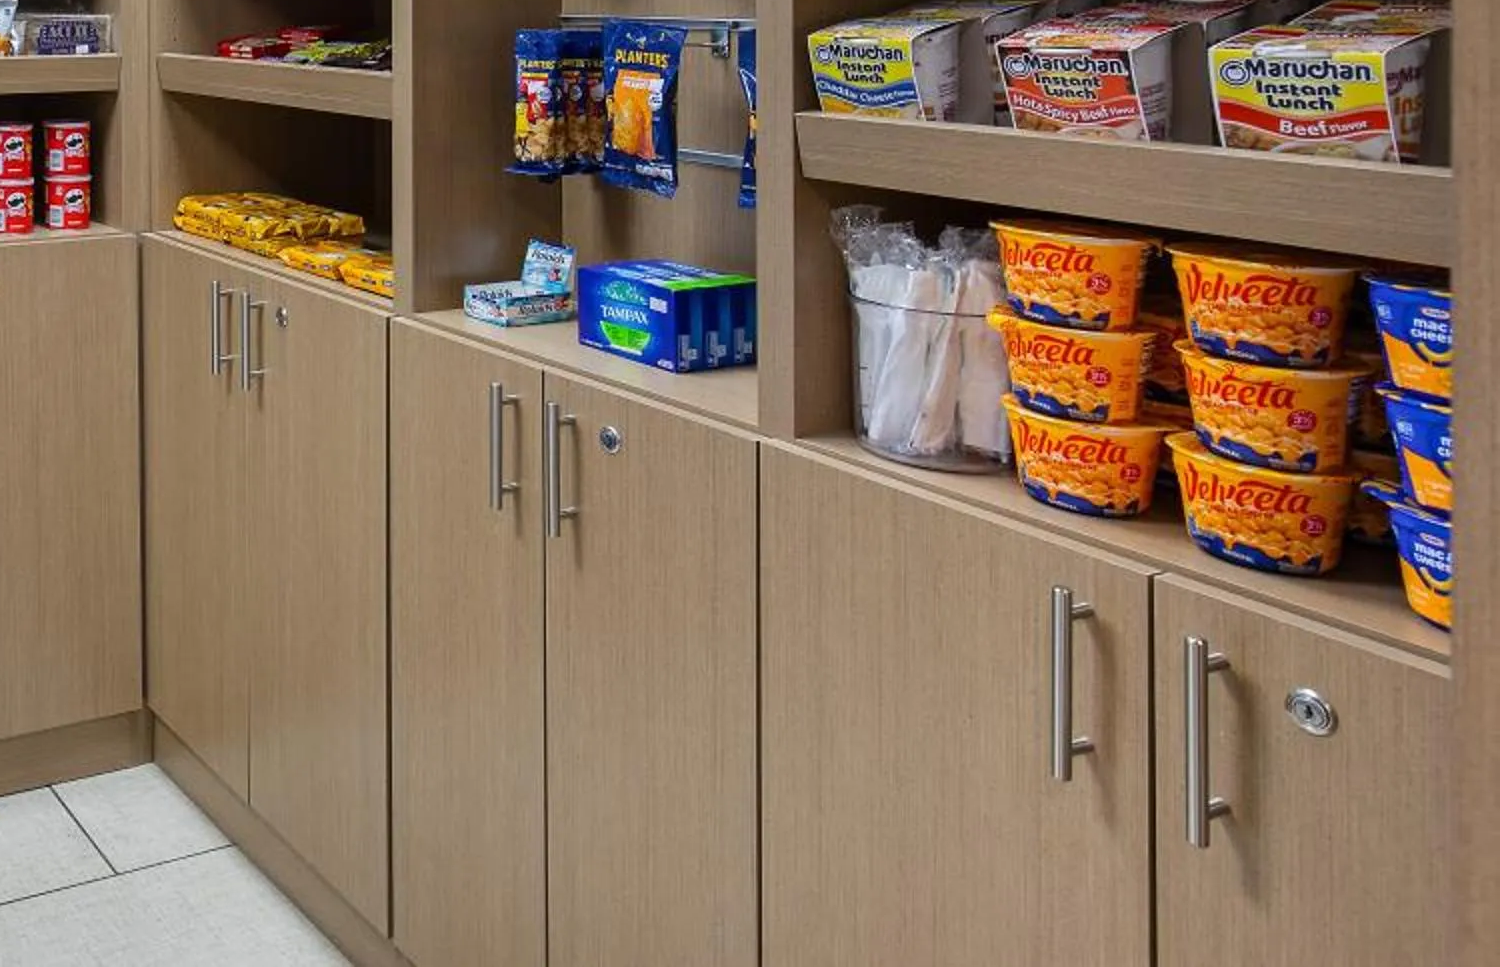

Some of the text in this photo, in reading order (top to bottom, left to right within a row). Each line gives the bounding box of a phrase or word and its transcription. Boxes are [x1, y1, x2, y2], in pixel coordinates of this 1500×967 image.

[615, 48, 671, 69] PLANTERS
[829, 44, 904, 61] Maruchan
[836, 60, 888, 74] Instant
[1023, 53, 1122, 74] Maruchan
[1244, 58, 1372, 82] Maruchan
[843, 70, 885, 84] Lunch
[1035, 73, 1102, 88] Instant
[1044, 85, 1097, 100] Lunch
[1256, 80, 1343, 97] Instant
[1267, 95, 1335, 112] Lunch
[1279, 119, 1327, 136] Beef
[1186, 262, 1317, 306] Velveeta
[601, 304, 649, 324] TAMPAX
[1413, 318, 1447, 333] mac
[1017, 419, 1129, 464] Velveeta
[1182, 460, 1313, 515] Velveeta
